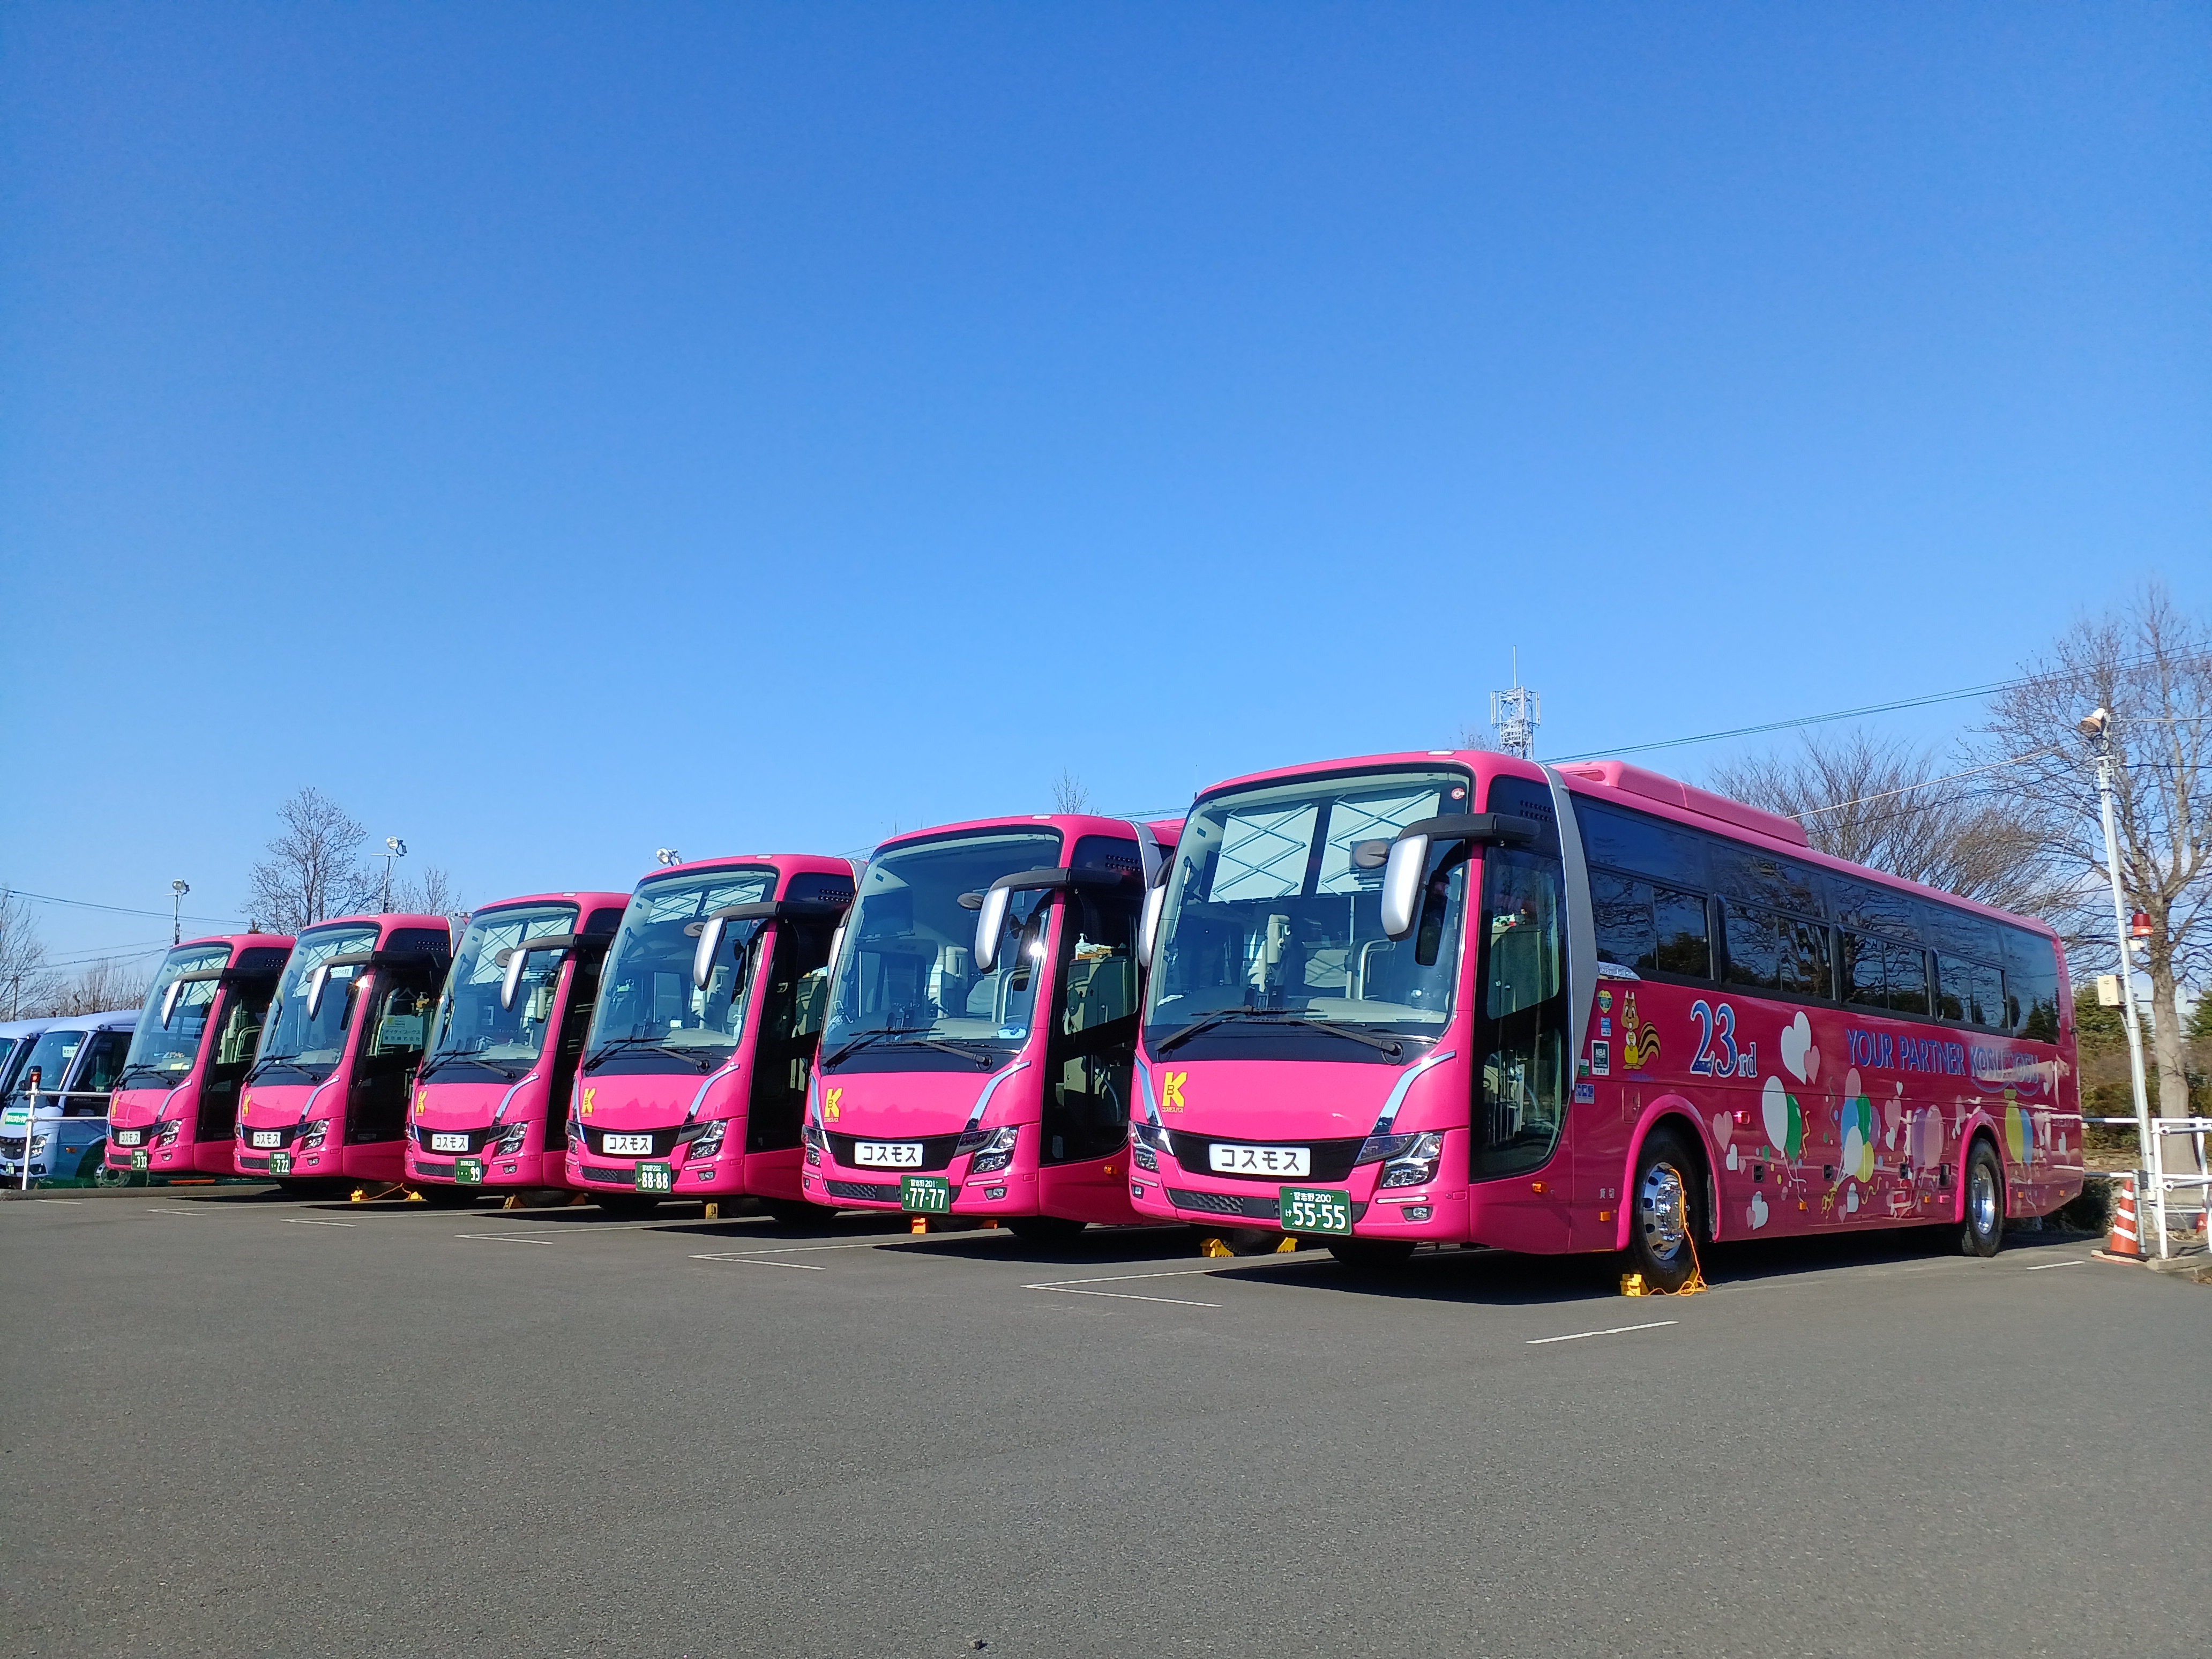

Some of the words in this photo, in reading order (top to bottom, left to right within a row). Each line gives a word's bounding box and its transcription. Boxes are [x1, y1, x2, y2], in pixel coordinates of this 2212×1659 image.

[1690, 999, 1758, 1078] 23rd
[1845, 1028, 1894, 1069] YOUR
[1899, 1035, 1966, 1077] PARTNER
[1969, 1045, 2039, 1084] KOSUOSU
[256, 1134, 279, 1145] コスモス
[436, 1137, 466, 1148] コスモス
[609, 1137, 648, 1150] コスモス
[863, 1146, 917, 1163] コスモス
[1221, 1148, 1300, 1172] コスモス
[1293, 1191, 1332, 1203] 習志野200
[1292, 1201, 1346, 1230] 55-55
